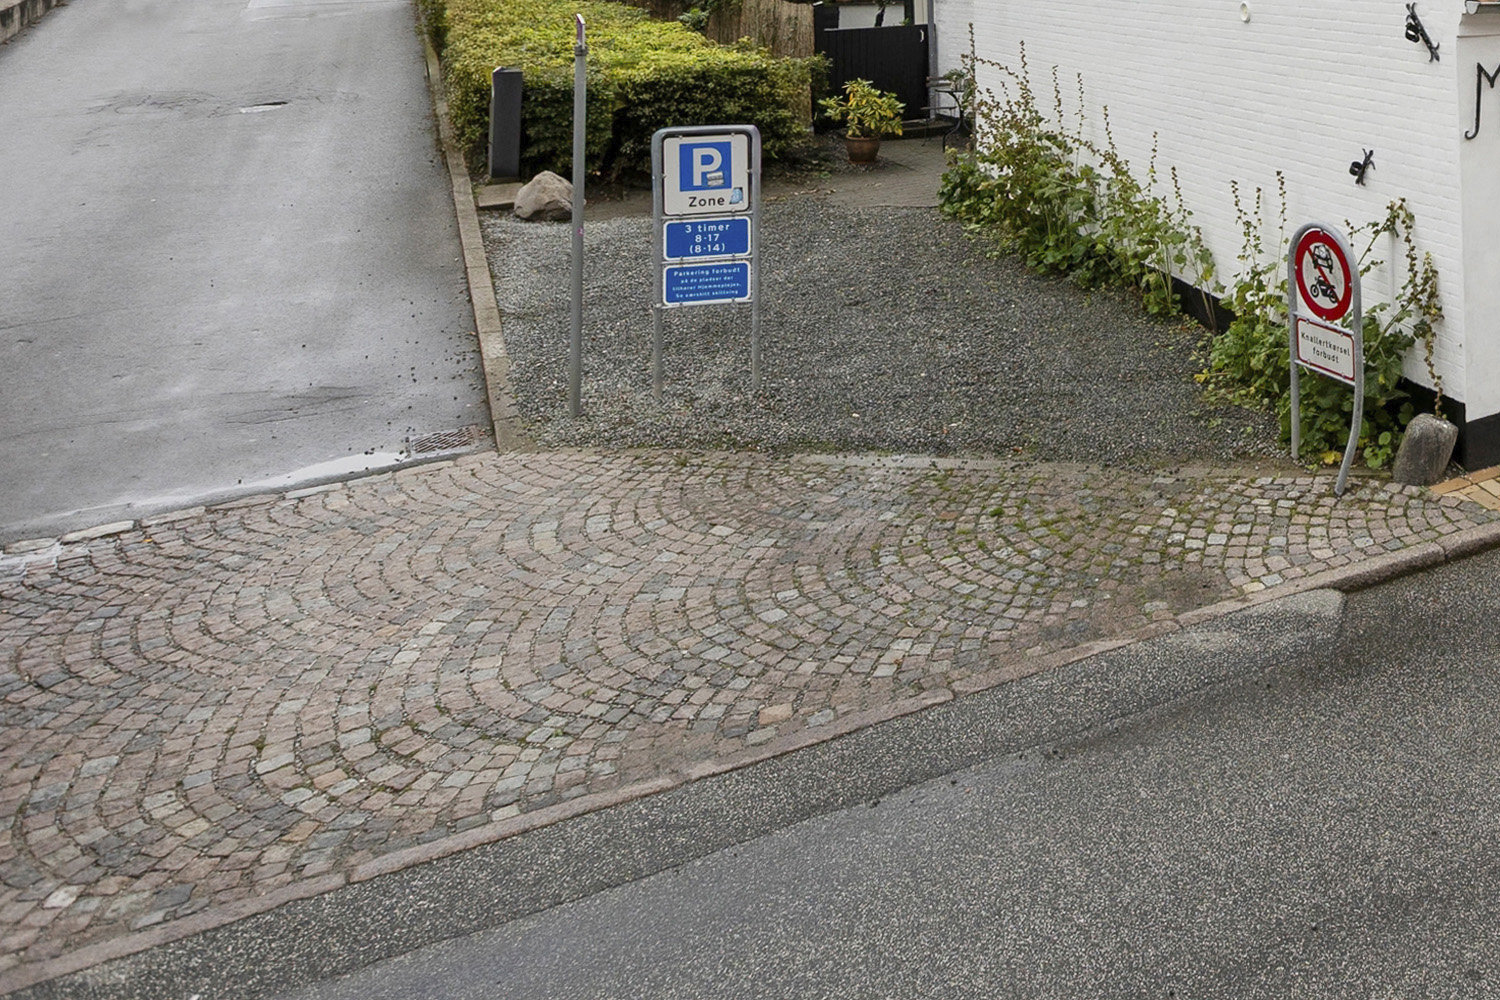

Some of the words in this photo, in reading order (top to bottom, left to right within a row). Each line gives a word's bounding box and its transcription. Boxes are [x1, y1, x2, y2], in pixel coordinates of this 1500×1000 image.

[692, 147, 722, 186] P
[688, 196, 725, 207] Zone
[685, 224, 692, 233] 3
[697, 224, 730, 233] timer
[695, 233, 720, 243] 8-17
[689, 243, 726, 254] (8-14)
[673, 269, 710, 277] Parkering
[712, 267, 740, 275] forbudt
[1312, 346, 1339, 363] forbudt
